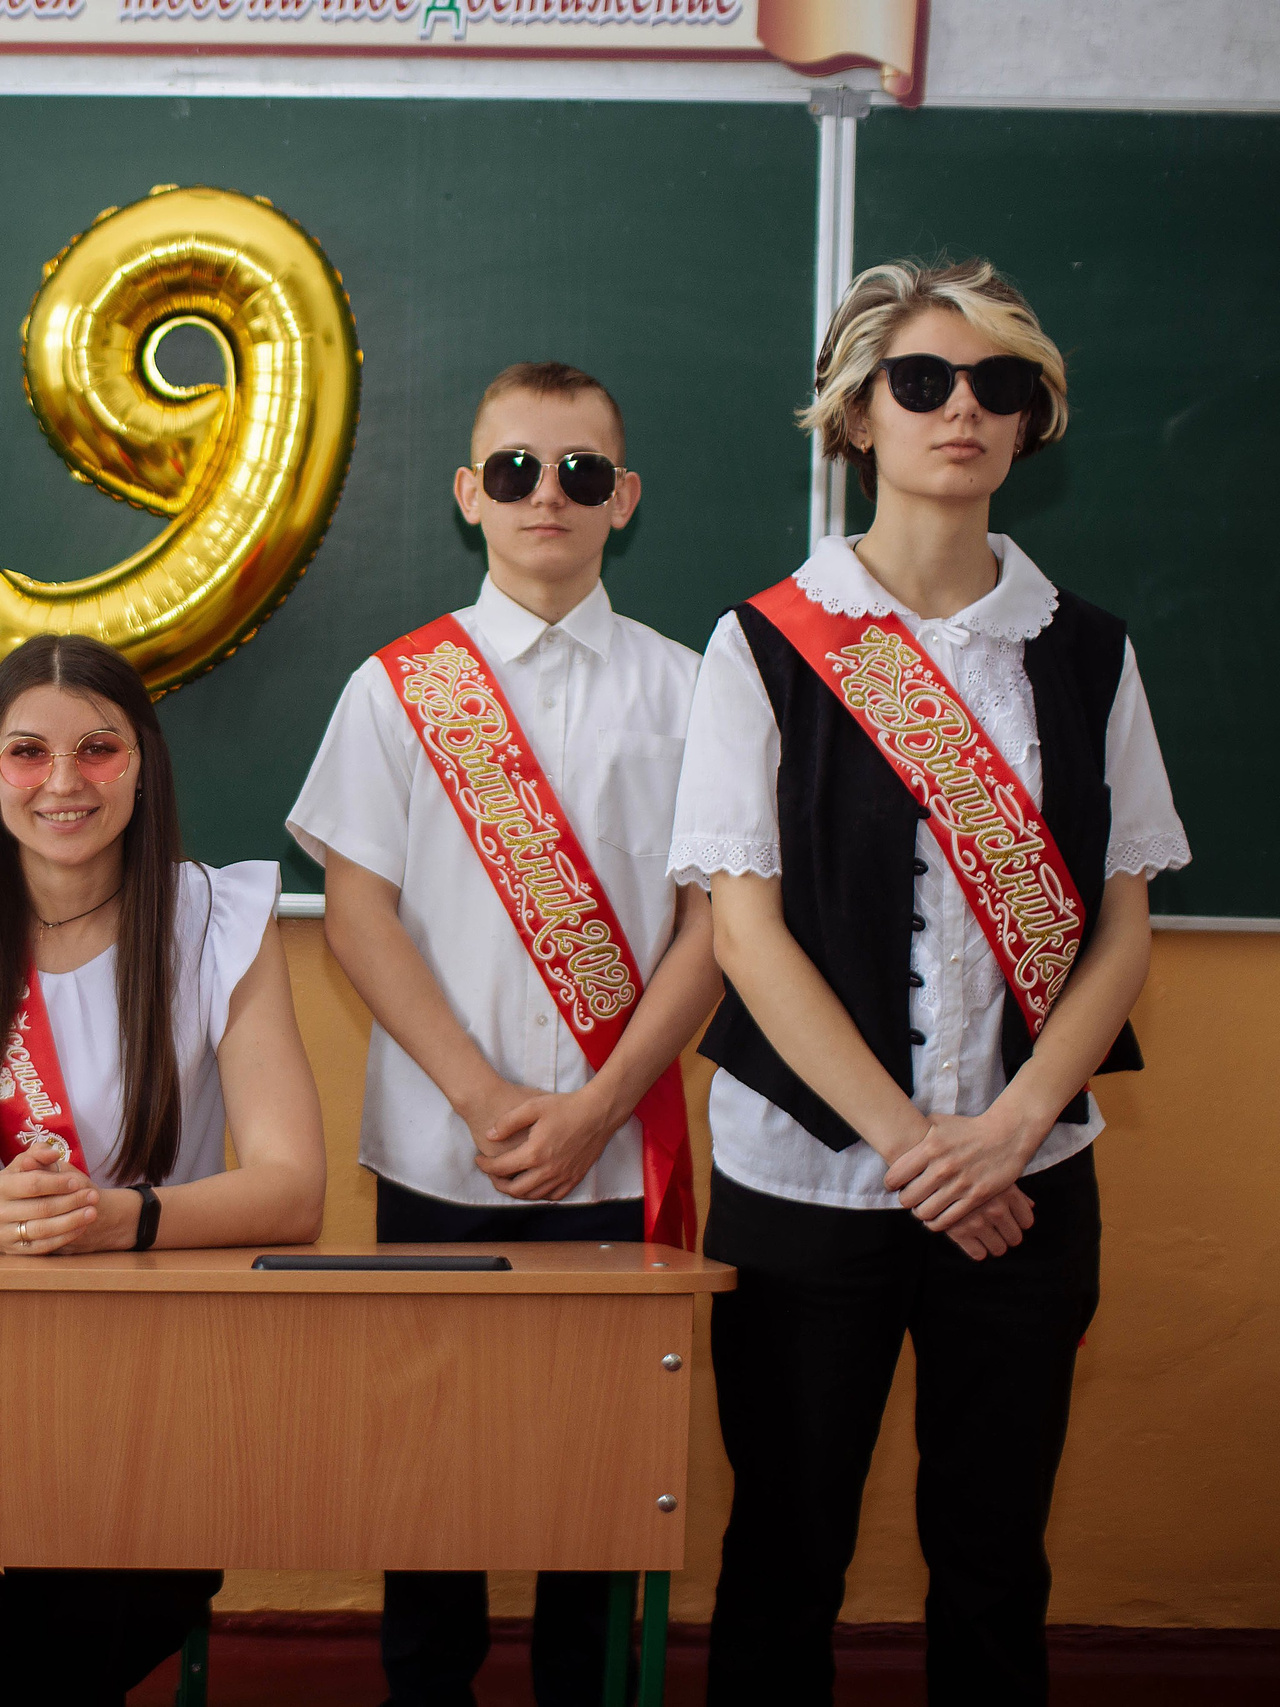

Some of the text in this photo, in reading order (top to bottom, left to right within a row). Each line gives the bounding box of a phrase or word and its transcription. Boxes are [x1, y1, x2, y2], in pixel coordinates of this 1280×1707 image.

[418, 682, 636, 1021] Выпускник 2023
[866, 681, 1080, 989] Выпускник
